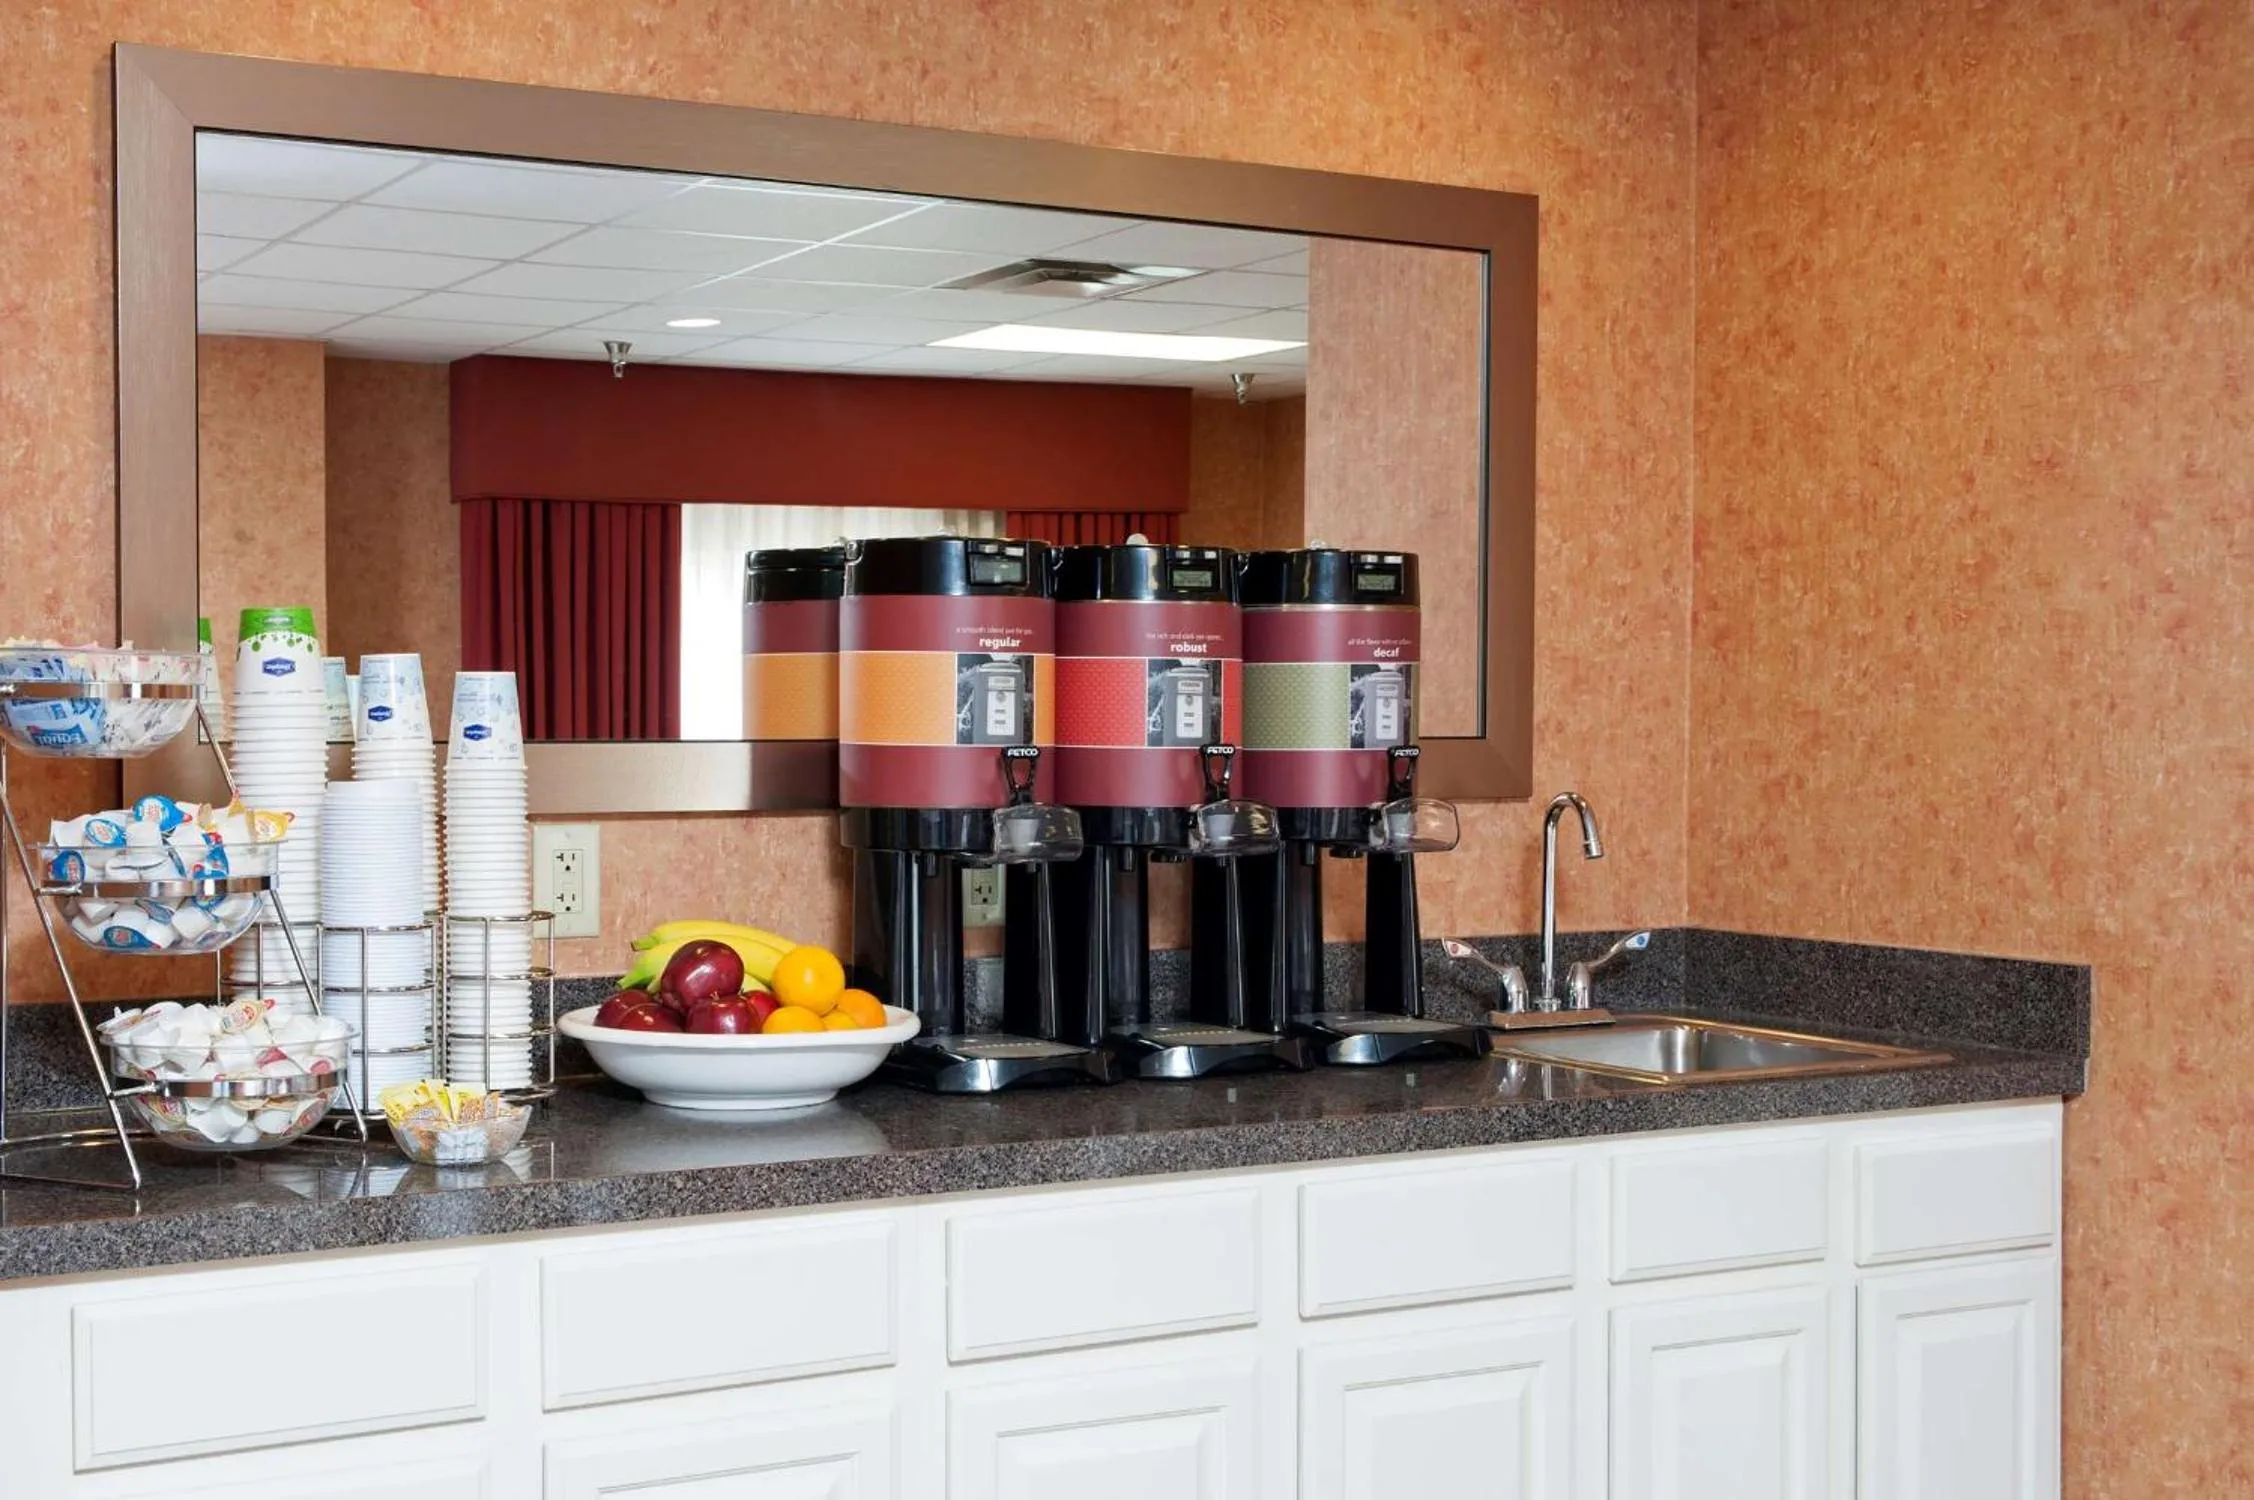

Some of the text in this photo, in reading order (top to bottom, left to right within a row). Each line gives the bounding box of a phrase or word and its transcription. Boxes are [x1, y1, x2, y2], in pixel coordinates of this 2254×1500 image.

[979, 636, 1021, 650] regular
[1170, 641, 1208, 653] robust
[1373, 647, 1400, 658] decaf
